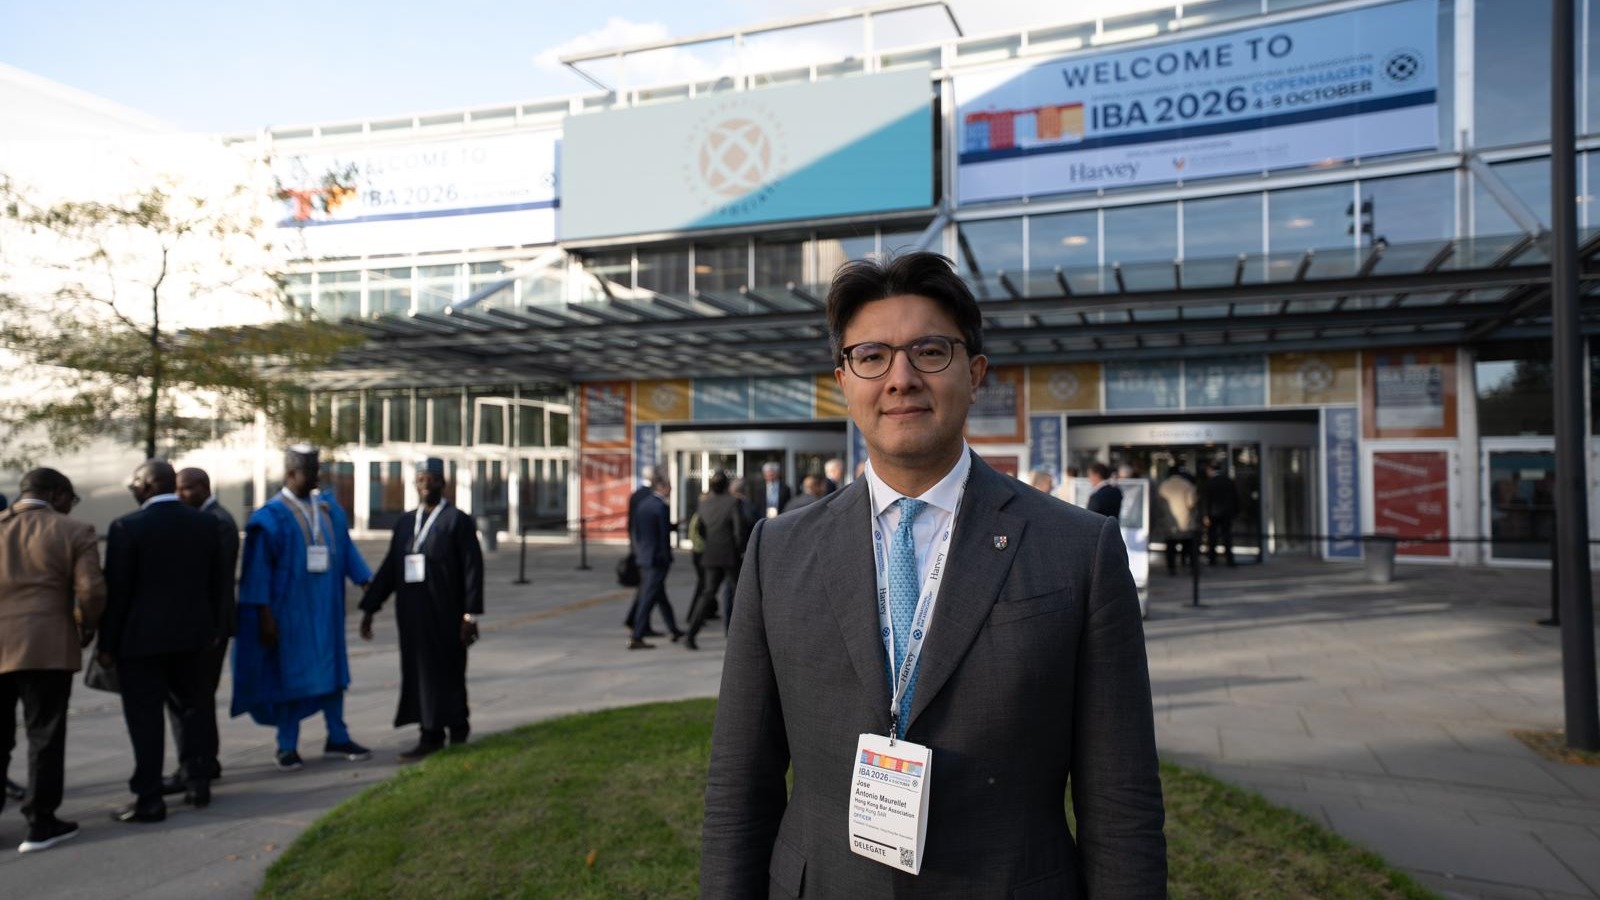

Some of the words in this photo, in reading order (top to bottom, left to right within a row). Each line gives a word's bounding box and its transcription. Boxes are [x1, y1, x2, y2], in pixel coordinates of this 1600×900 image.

[1062, 43, 1233, 88] WELCOME
[1245, 34, 1293, 61] TO
[1252, 64, 1374, 95] COPENHAGEN
[1285, 80, 1373, 106] OCTOBER
[1091, 99, 1149, 131] IBA
[1154, 86, 1248, 123] 2026
[348, 149, 449, 176] ELCOME
[1068, 161, 1140, 183] Harvey
[403, 183, 460, 206] 2026
[930, 552, 945, 580] Harvey
[879, 587, 887, 616] Harvey
[900, 651, 916, 682] Harvey
[856, 780, 870, 788] Jose
[859, 767, 870, 777] IBA
[871, 770, 889, 782] 2026
[855, 788, 878, 801] Antonio
[879, 794, 907, 808] Maurellet
[855, 797, 866, 806] Hong
[867, 801, 879, 810] Kong
[888, 807, 915, 818] Association
[853, 812, 872, 821] OFFICER
[853, 840, 887, 857] DELEGATE
